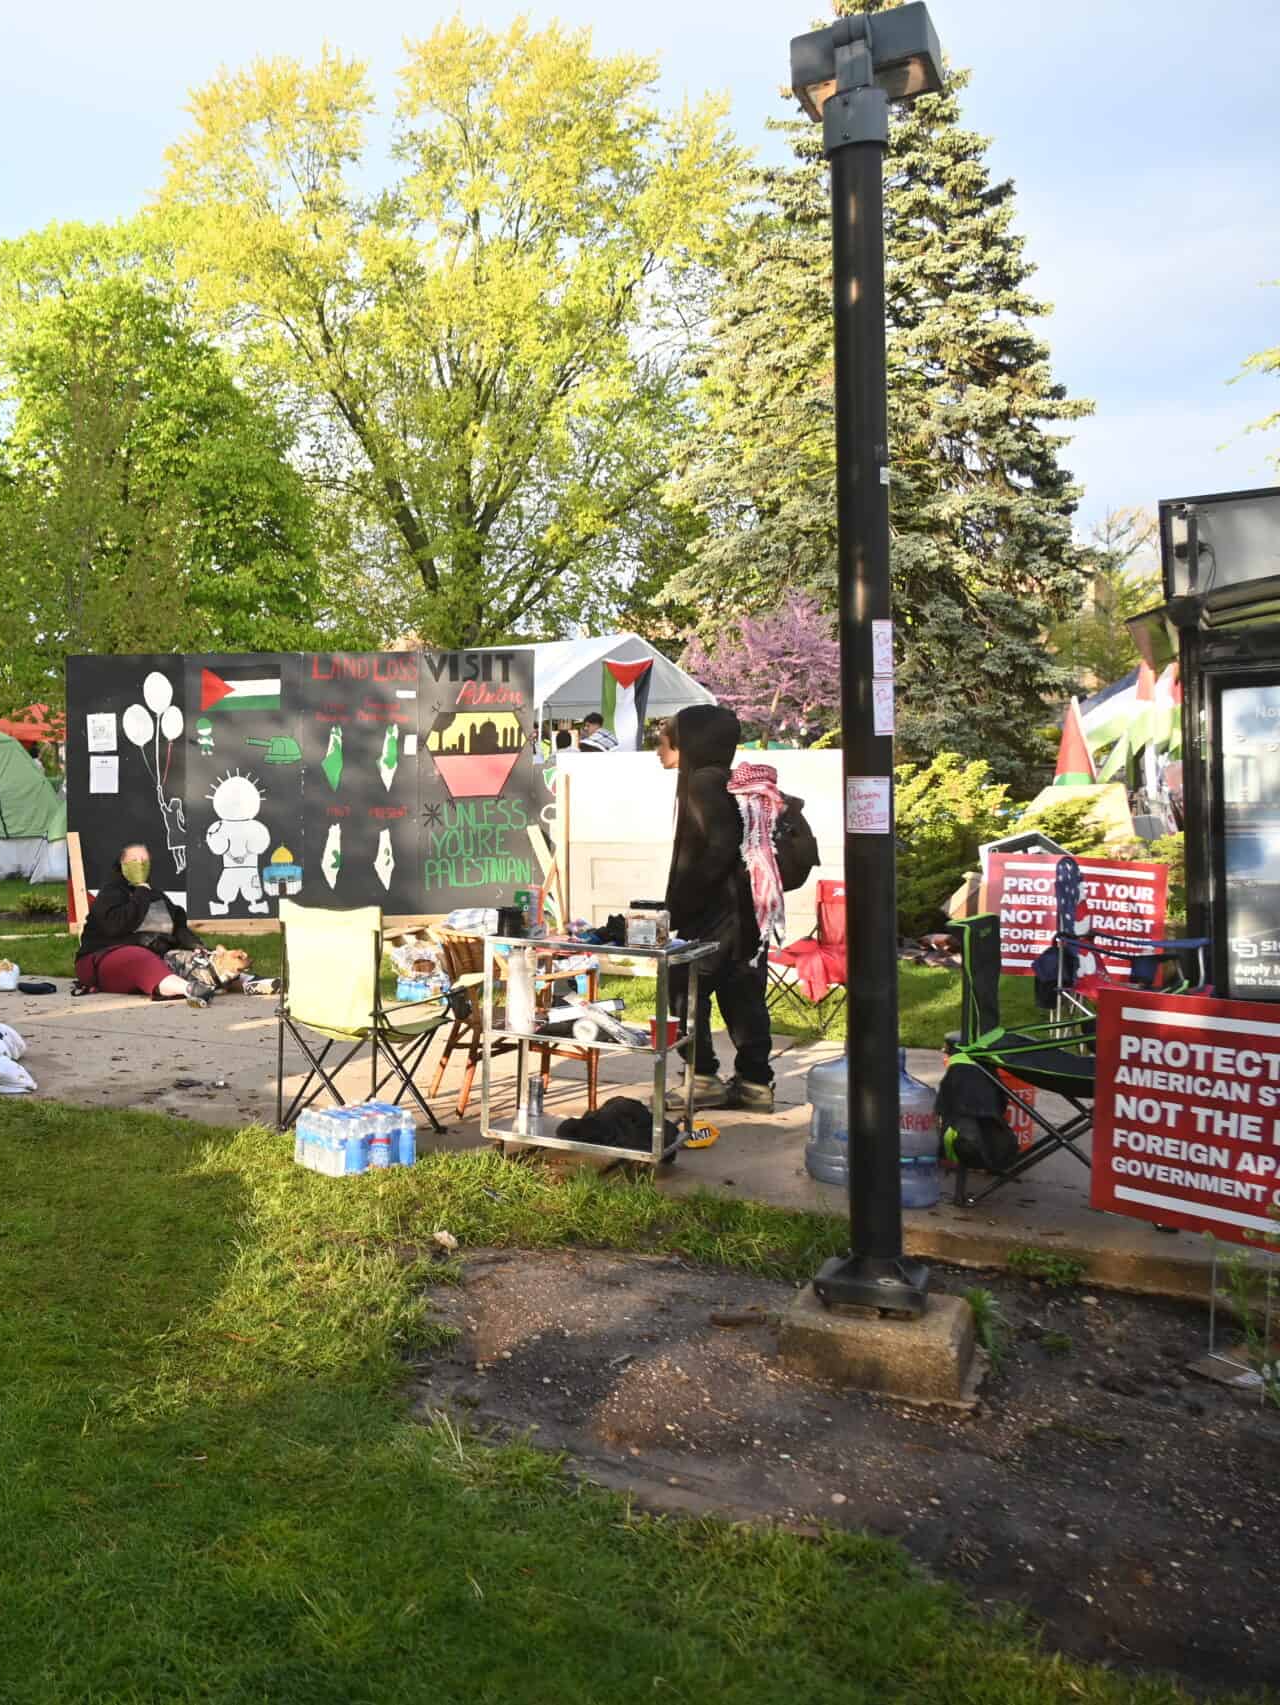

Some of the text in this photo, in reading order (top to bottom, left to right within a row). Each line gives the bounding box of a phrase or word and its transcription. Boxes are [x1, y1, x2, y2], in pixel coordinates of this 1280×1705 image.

[312, 656, 417, 682] LAND LOSS
[424, 655, 515, 682] VISIT
[442, 800, 529, 829] UNLESS
[1087, 898, 1156, 916] STUDENTS
[1104, 883, 1155, 902] YOUR
[1000, 908, 1155, 934] NOT RACIST
[1120, 1034, 1280, 1081] PROTECT
[1114, 1065, 1250, 1104] AMERICAN
[1114, 1093, 1183, 1128] NOT
[1191, 1106, 1263, 1143] THE
[1112, 1128, 1280, 1180] FOREIGN AP
[1111, 1156, 1267, 1202] GOVERNMENT
